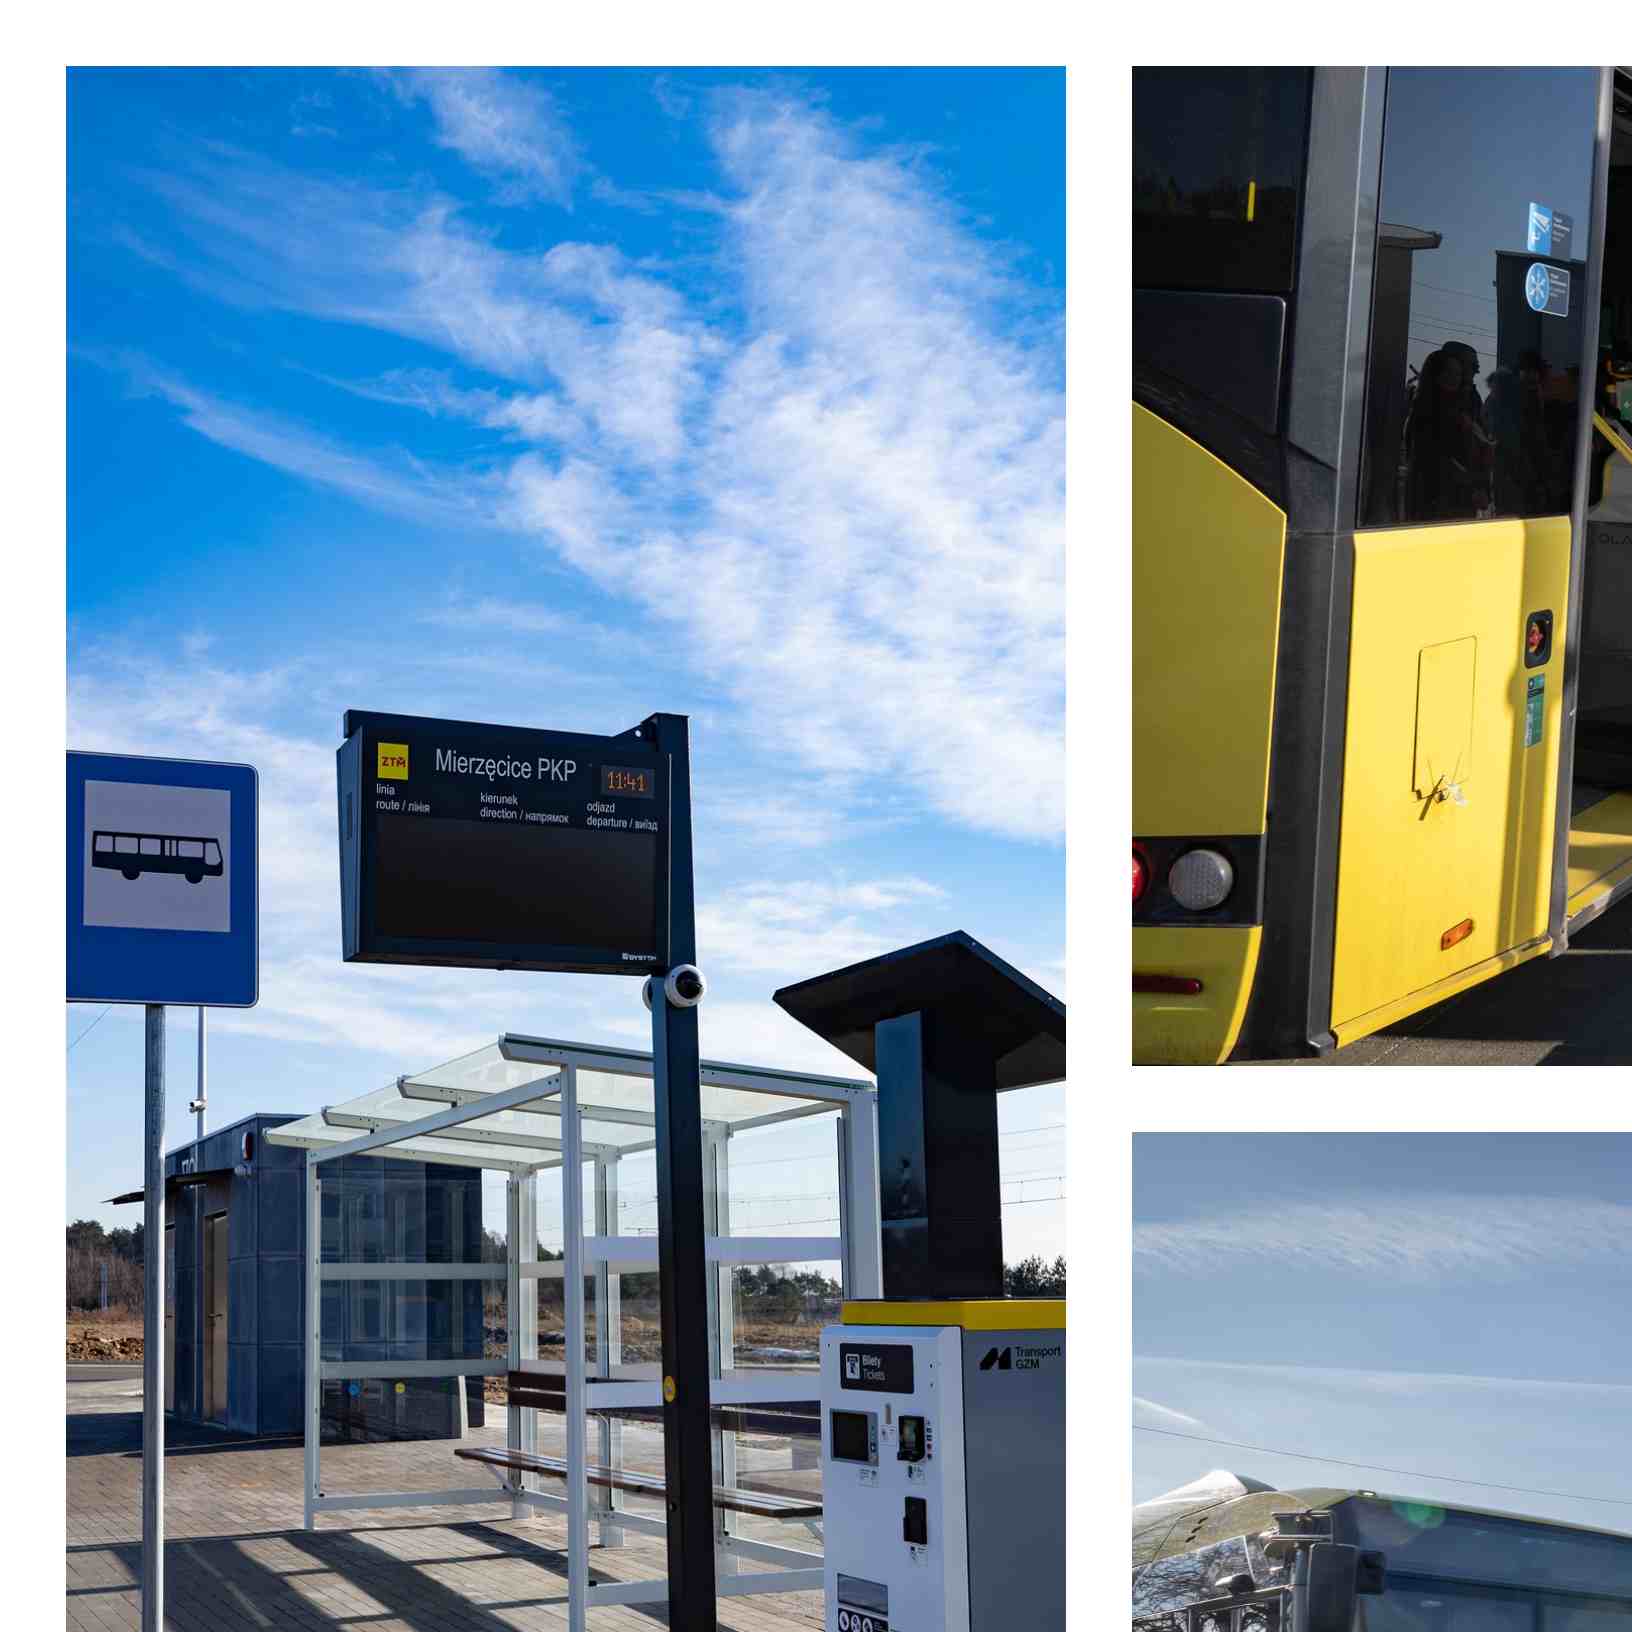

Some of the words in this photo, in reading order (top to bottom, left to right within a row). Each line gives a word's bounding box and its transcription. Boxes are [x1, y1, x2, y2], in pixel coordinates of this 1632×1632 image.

[435, 748, 532, 781] Mierzęcice
[537, 757, 577, 781] PKP
[607, 771, 646, 791] 11:41
[376, 783, 396, 796] linia
[376, 799, 400, 811] route
[480, 791, 518, 806] kierunek
[480, 806, 518, 820] direction
[586, 801, 616, 814] odjazd
[586, 815, 628, 829] departure
[1015, 1346, 1061, 1360] Transport
[1015, 1358, 1040, 1369] GZM
